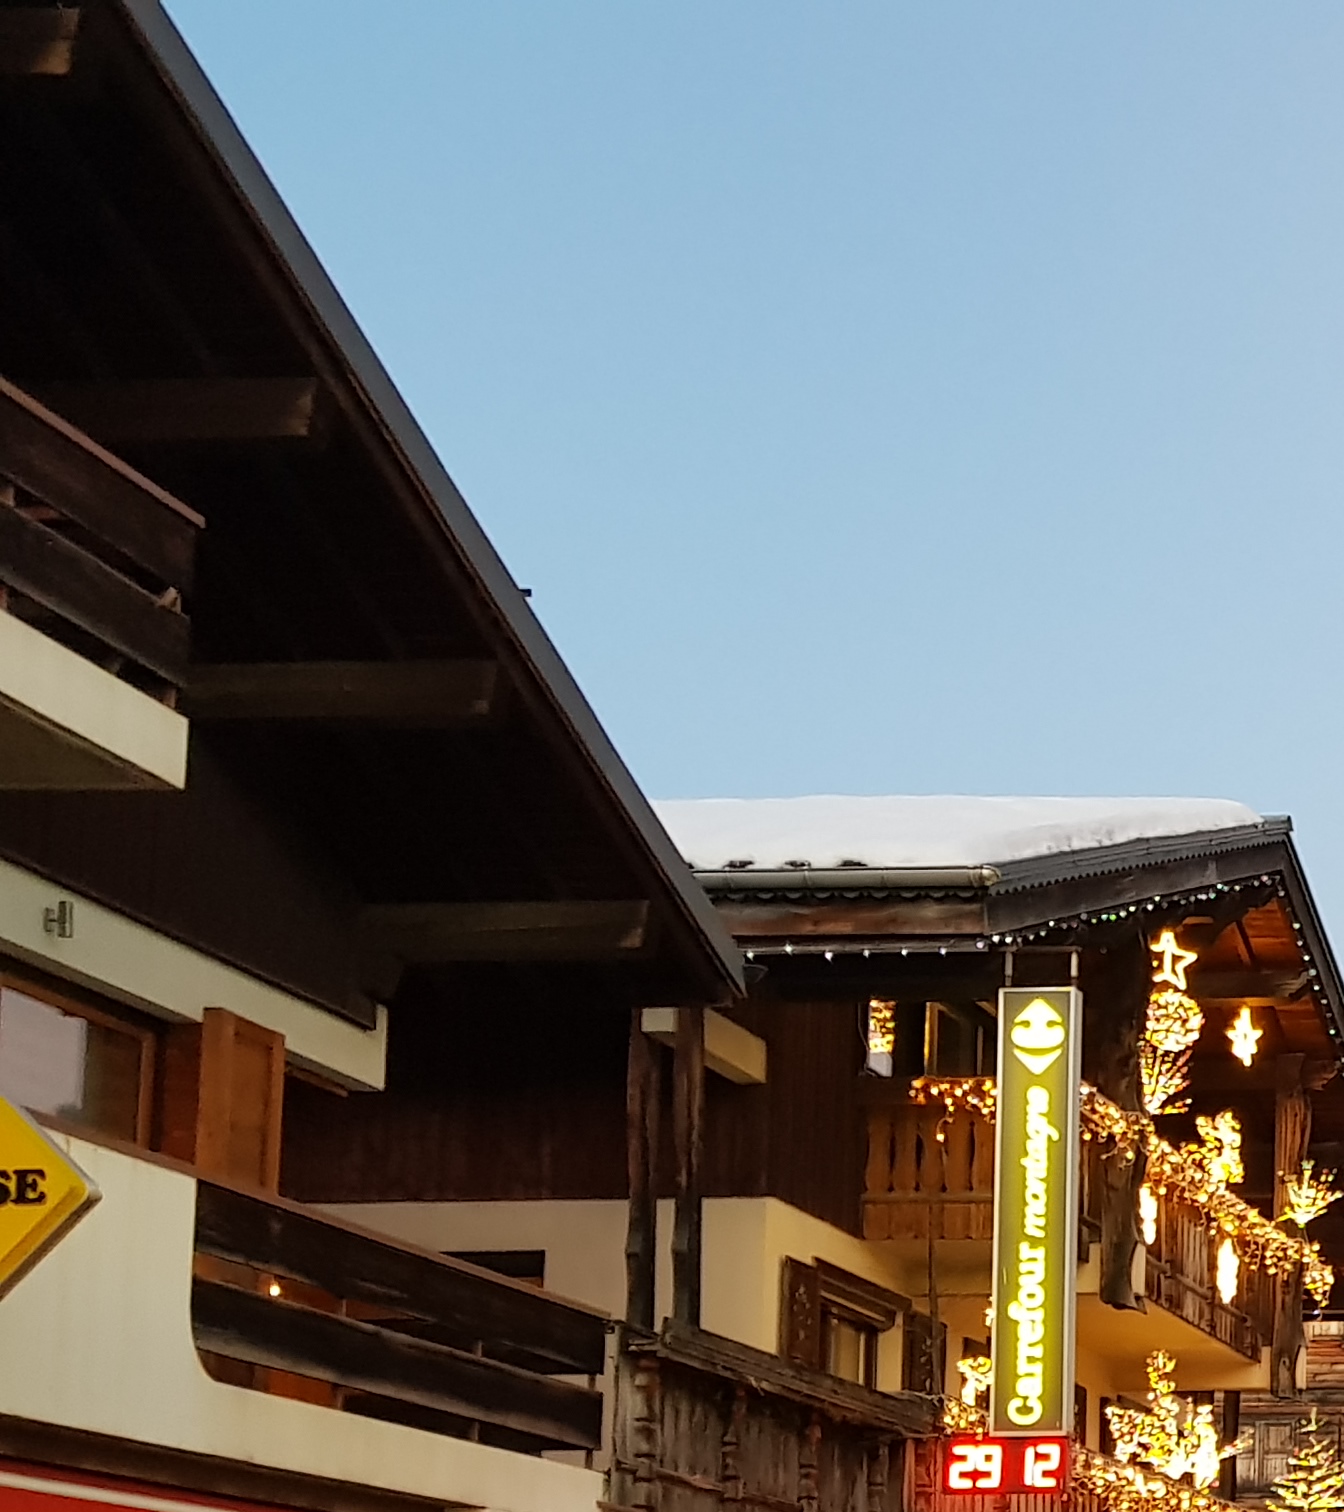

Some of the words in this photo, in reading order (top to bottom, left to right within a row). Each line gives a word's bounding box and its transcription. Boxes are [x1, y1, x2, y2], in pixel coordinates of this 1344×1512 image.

[1020, 1085, 1060, 1239] montagne
[1007, 1242, 1046, 1426] Carrefour
[949, 1444, 1003, 1490] 29
[1023, 1443, 1062, 1488] 12
